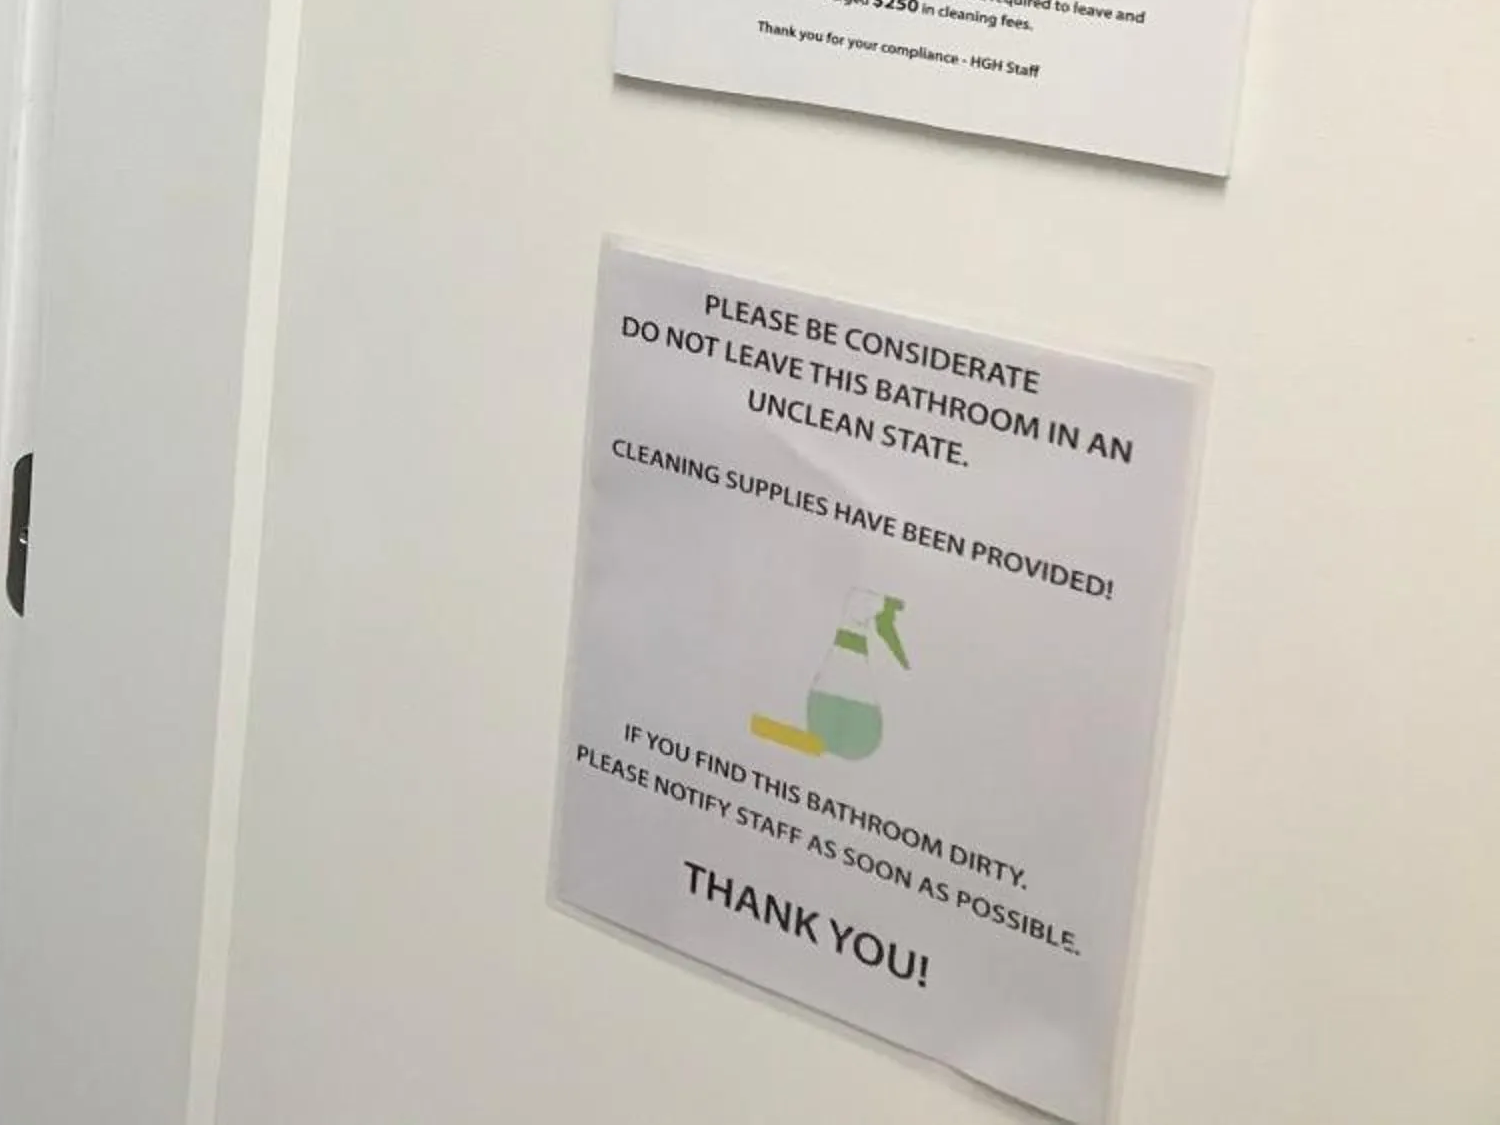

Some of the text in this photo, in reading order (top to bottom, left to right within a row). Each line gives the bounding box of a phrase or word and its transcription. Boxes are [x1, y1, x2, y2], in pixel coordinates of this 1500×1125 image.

[757, 20, 797, 38] Thank
[798, 30, 824, 43] you
[825, 31, 845, 46] for
[847, 37, 879, 52] your
[879, 42, 960, 65] compliance
[969, 55, 1004, 72] HGH
[1005, 60, 1041, 78] Staff
[921, 2, 935, 16] in
[937, 5, 998, 28] cleaning
[1000, 13, 1033, 31] fees.
[1054, 0, 1071, 14] to
[1072, 0, 1113, 20] leave
[1115, 10, 1147, 24] and
[621, 315, 1133, 464] DO NOT LEAVE THIS BATHROOM IN AN
[705, 294, 1041, 395] PLEASE BE CONSIDERATE
[747, 388, 969, 468] UNCLEAN STATE.
[611, 438, 1114, 601] CLEANING SUPPLIES HAVE BEEN PROVIDED!
[576, 743, 1080, 956] PLEASE NOTIFY STAFF AS SOON AS POSSIBLE.
[624, 723, 1027, 891] IF YOU FIND THIS BATHROOM DIRTY.
[683, 860, 929, 988] THANK YOU!
